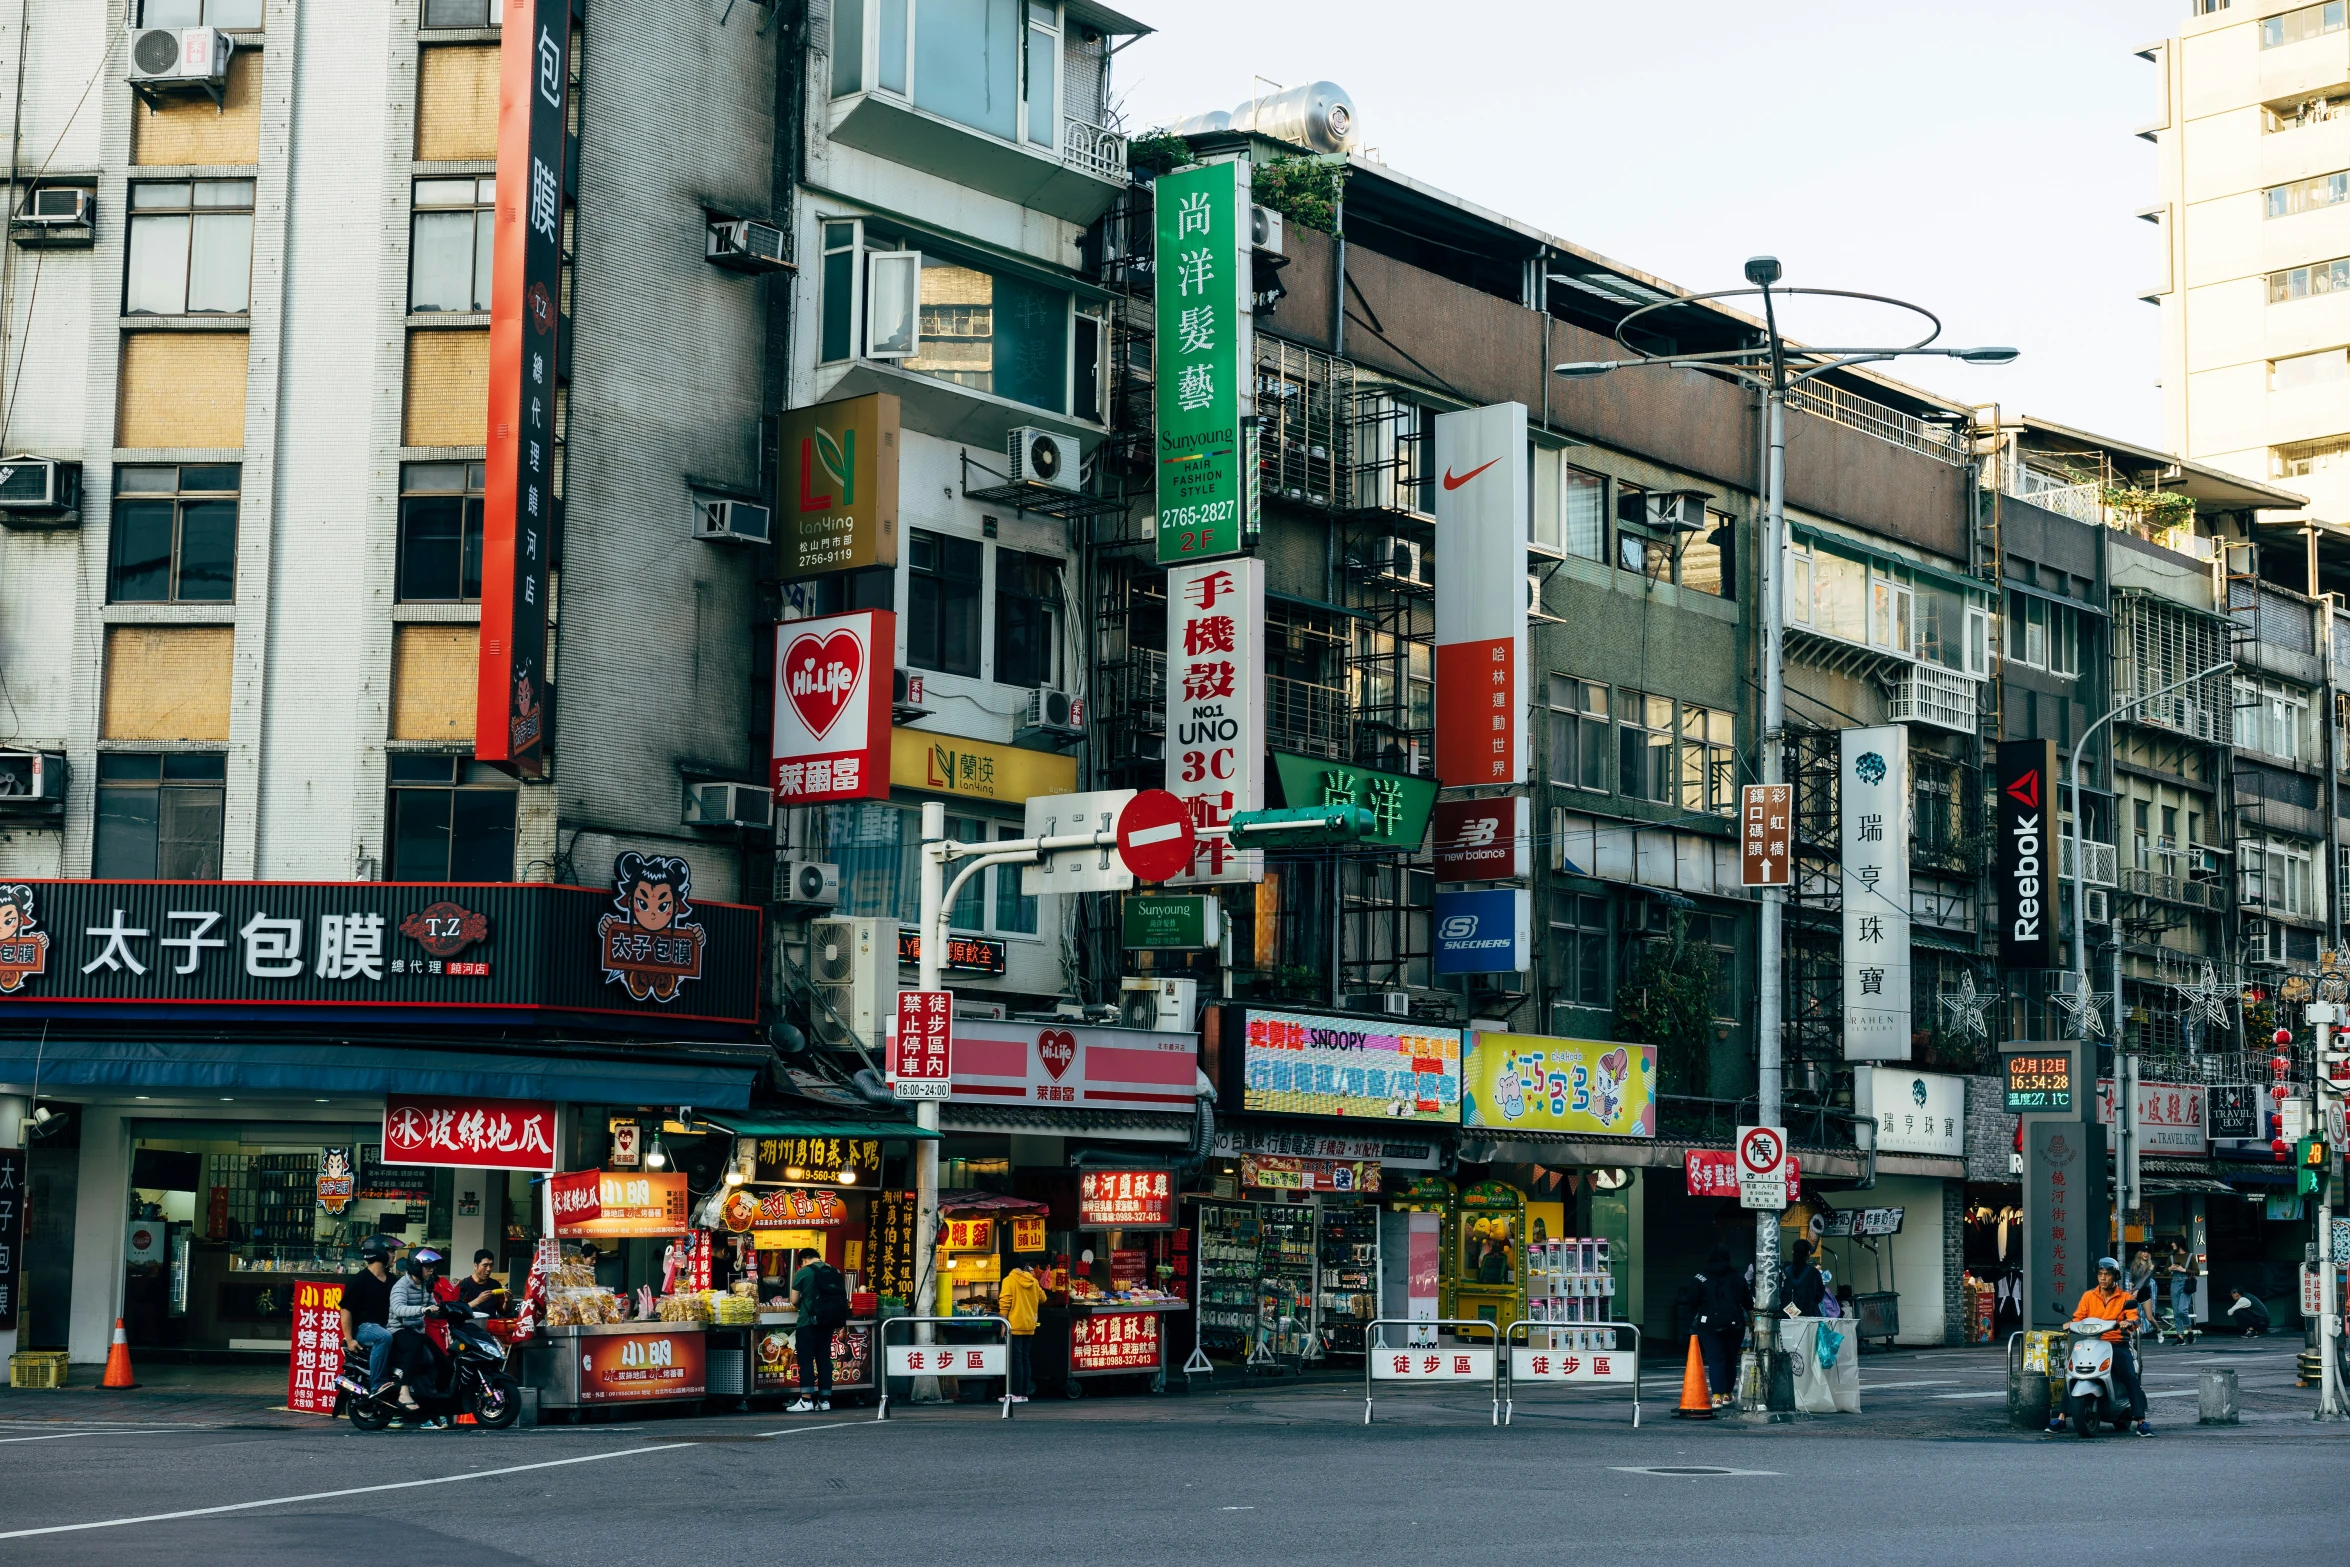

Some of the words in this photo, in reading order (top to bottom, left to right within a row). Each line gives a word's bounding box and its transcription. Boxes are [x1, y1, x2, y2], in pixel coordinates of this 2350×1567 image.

[531, 24, 560, 244] 包膜
[1178, 192, 1215, 412] 尚洋髮藝
[1162, 428, 1234, 452] Sunyoung
[1173, 470, 1222, 486] FASHION
[1185, 460, 1211, 472] HAIR
[1180, 484, 1215, 497] STYLE
[1162, 500, 1235, 528] 2765-2827
[799, 534, 853, 553] 松山門市部
[1180, 529, 1214, 552] 2F
[799, 548, 852, 567] 2756-9119
[1182, 570, 1236, 702] 手機殼
[1192, 704, 1224, 719] NO.1
[1492, 647, 1506, 776] 哈林運動世界
[1178, 718, 1239, 745] UNO
[779, 757, 860, 797] 萊爾富
[960, 753, 994, 783] 蘭瑛
[1181, 748, 1235, 782] 3C
[1325, 770, 1403, 836] 尚洋
[1748, 788, 1765, 857] 錫口碼頭
[1770, 788, 1786, 857] 彩虹橋
[1444, 853, 1465, 862] new
[1465, 849, 1506, 862] balance
[2013, 813, 2039, 941] Reebok
[1138, 901, 1190, 918] Sunyoung
[1858, 813, 1884, 996] 瑞亨珠寶
[425, 918, 460, 937] T.Z
[81, 908, 387, 980] 太子包膜
[612, 932, 692, 965] 太子包膜
[1444, 939, 1511, 950] SKECHERS
[391, 959, 442, 974] 總代理
[450, 962, 487, 975] 饒河店
[902, 994, 922, 1076] 禁止停車
[926, 994, 946, 1076] 徒步區內
[1310, 1027, 1367, 1051] SNOOPY
[898, 1084, 948, 1097] 16:00~24:00
[1037, 1085, 1074, 1102] 萊爾富
[2010, 1075, 2068, 1089] 16:54:28
[1883, 1112, 1955, 1138] 瑞亨珠寶
[2213, 1109, 2251, 1118] TRAVEL
[2223, 1118, 2242, 1127] FOX
[388, 1107, 553, 1154] 冰拔絲地瓜
[2158, 1132, 2184, 1145] TRAVEL
[2185, 1133, 2199, 1146] FOX
[1267, 1135, 1316, 1157] 行動電源
[1750, 1138, 1772, 1162] 停
[320, 1179, 350, 1195] 太子包膜
[790, 1169, 842, 1181] 0919-560-83
[1082, 1173, 1169, 1199] 饒河鹽酥雞
[1258, 1173, 1299, 1187] 行動電源
[600, 1179, 649, 1206] 小明
[883, 1190, 902, 1204] 潮州
[952, 1222, 989, 1247] 鴨頭
[2051, 1170, 2067, 1297] 饒河街觀光夜市
[300, 1285, 342, 1311] 小明
[1074, 1315, 1157, 1344] 饒河鹽酥雞
[294, 1308, 319, 1390] 冰烤地瓜
[317, 1311, 341, 1392] 拔絲地瓜
[622, 1339, 672, 1367] 小明
[907, 1351, 984, 1370] 徒步區
[1393, 1355, 1471, 1374] 徒步區
[1532, 1356, 1611, 1375] 徒步區
